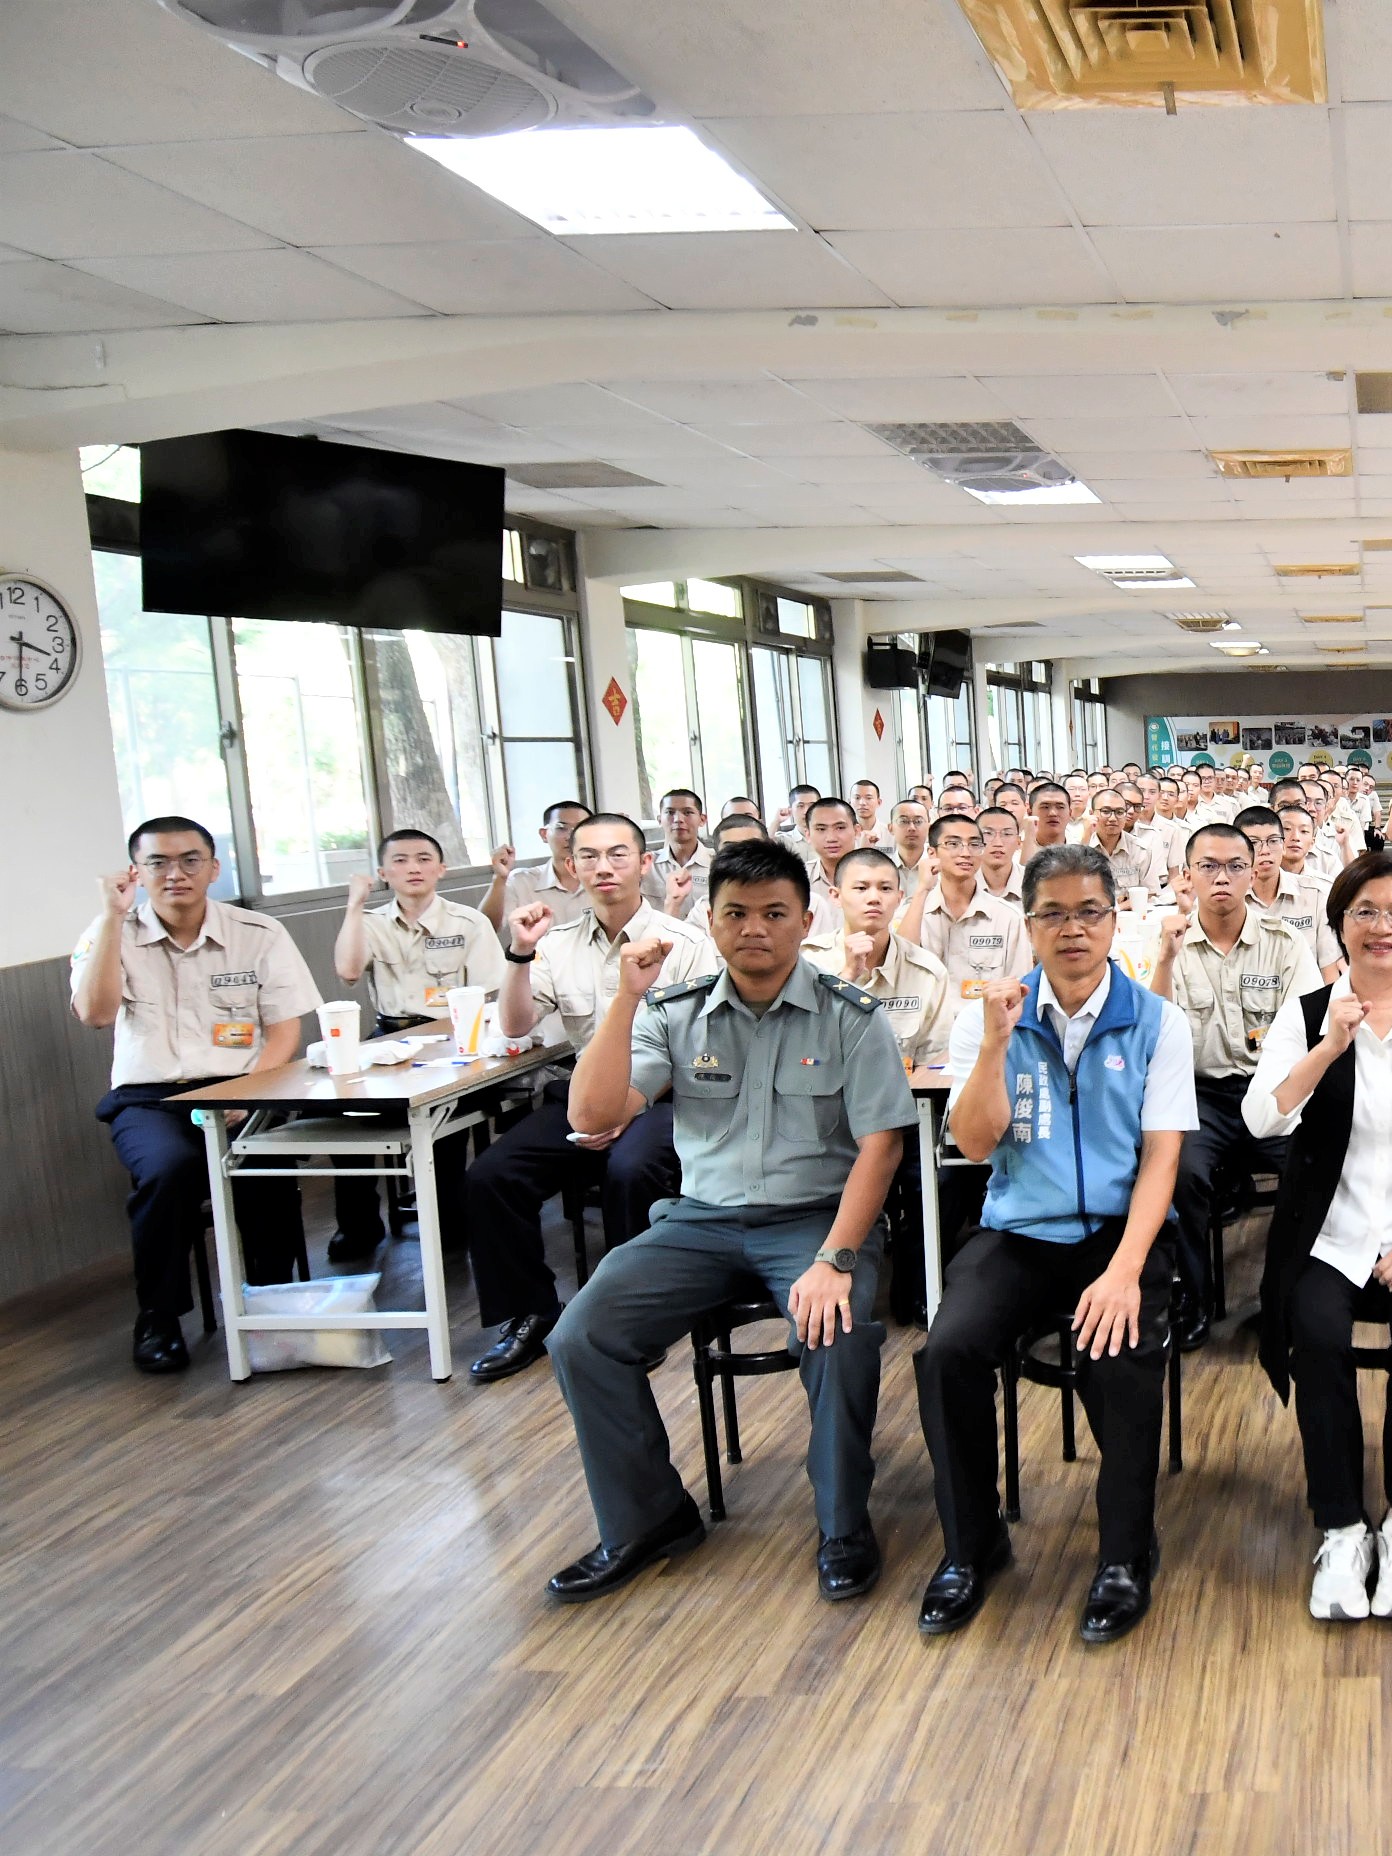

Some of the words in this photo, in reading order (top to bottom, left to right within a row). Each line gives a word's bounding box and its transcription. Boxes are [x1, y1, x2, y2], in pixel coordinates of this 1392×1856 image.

[6, 587, 25, 605] 12
[34, 596, 40, 613] 1
[46, 615, 59, 632] 2
[52, 636, 64, 653] 3
[48, 658, 60, 674] 4
[14, 678, 28, 696] 6
[35, 673, 47, 690] 5
[608, 687, 621, 717] 吉
[1243, 976, 1278, 986] 09078
[1012, 1073, 1034, 1143] 陳俊南
